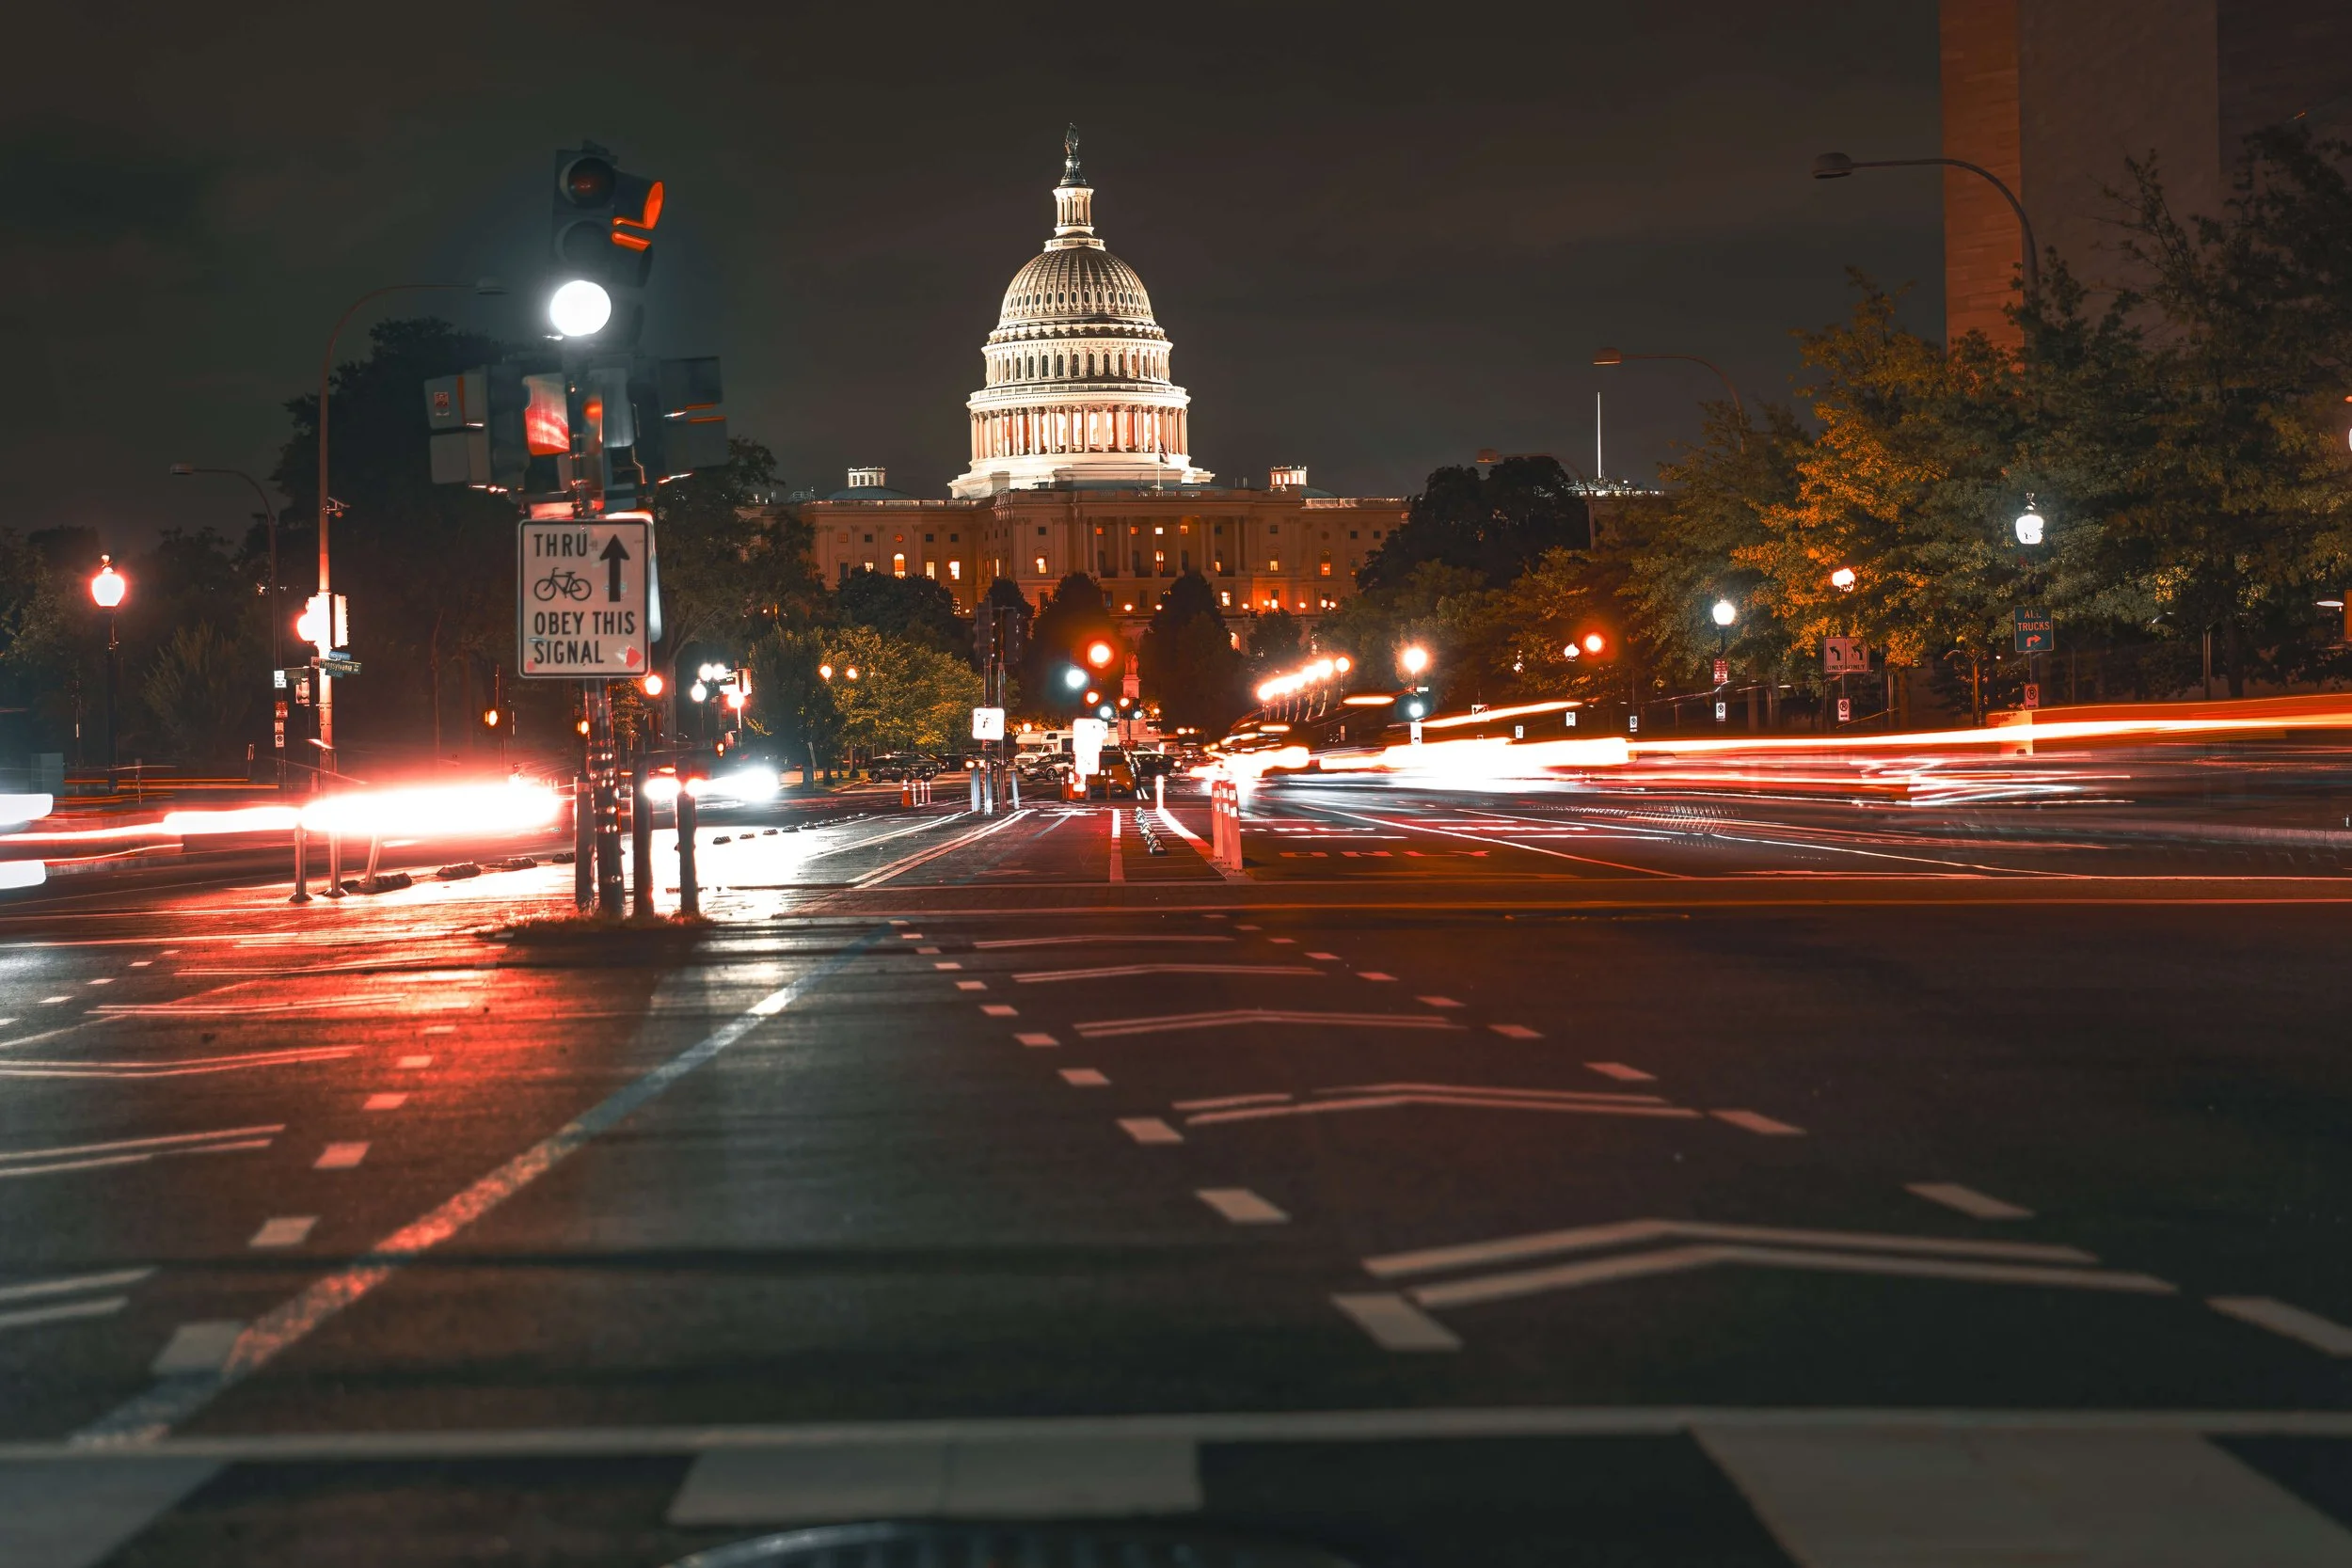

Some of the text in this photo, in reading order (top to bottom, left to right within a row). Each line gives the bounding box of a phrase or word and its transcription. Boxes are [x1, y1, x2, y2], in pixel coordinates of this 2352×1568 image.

[533, 533, 588, 558] THRU
[534, 611, 636, 635] OBEY THIS
[2017, 621, 2050, 631] TRUCKS
[533, 640, 605, 664] SIGNAL
